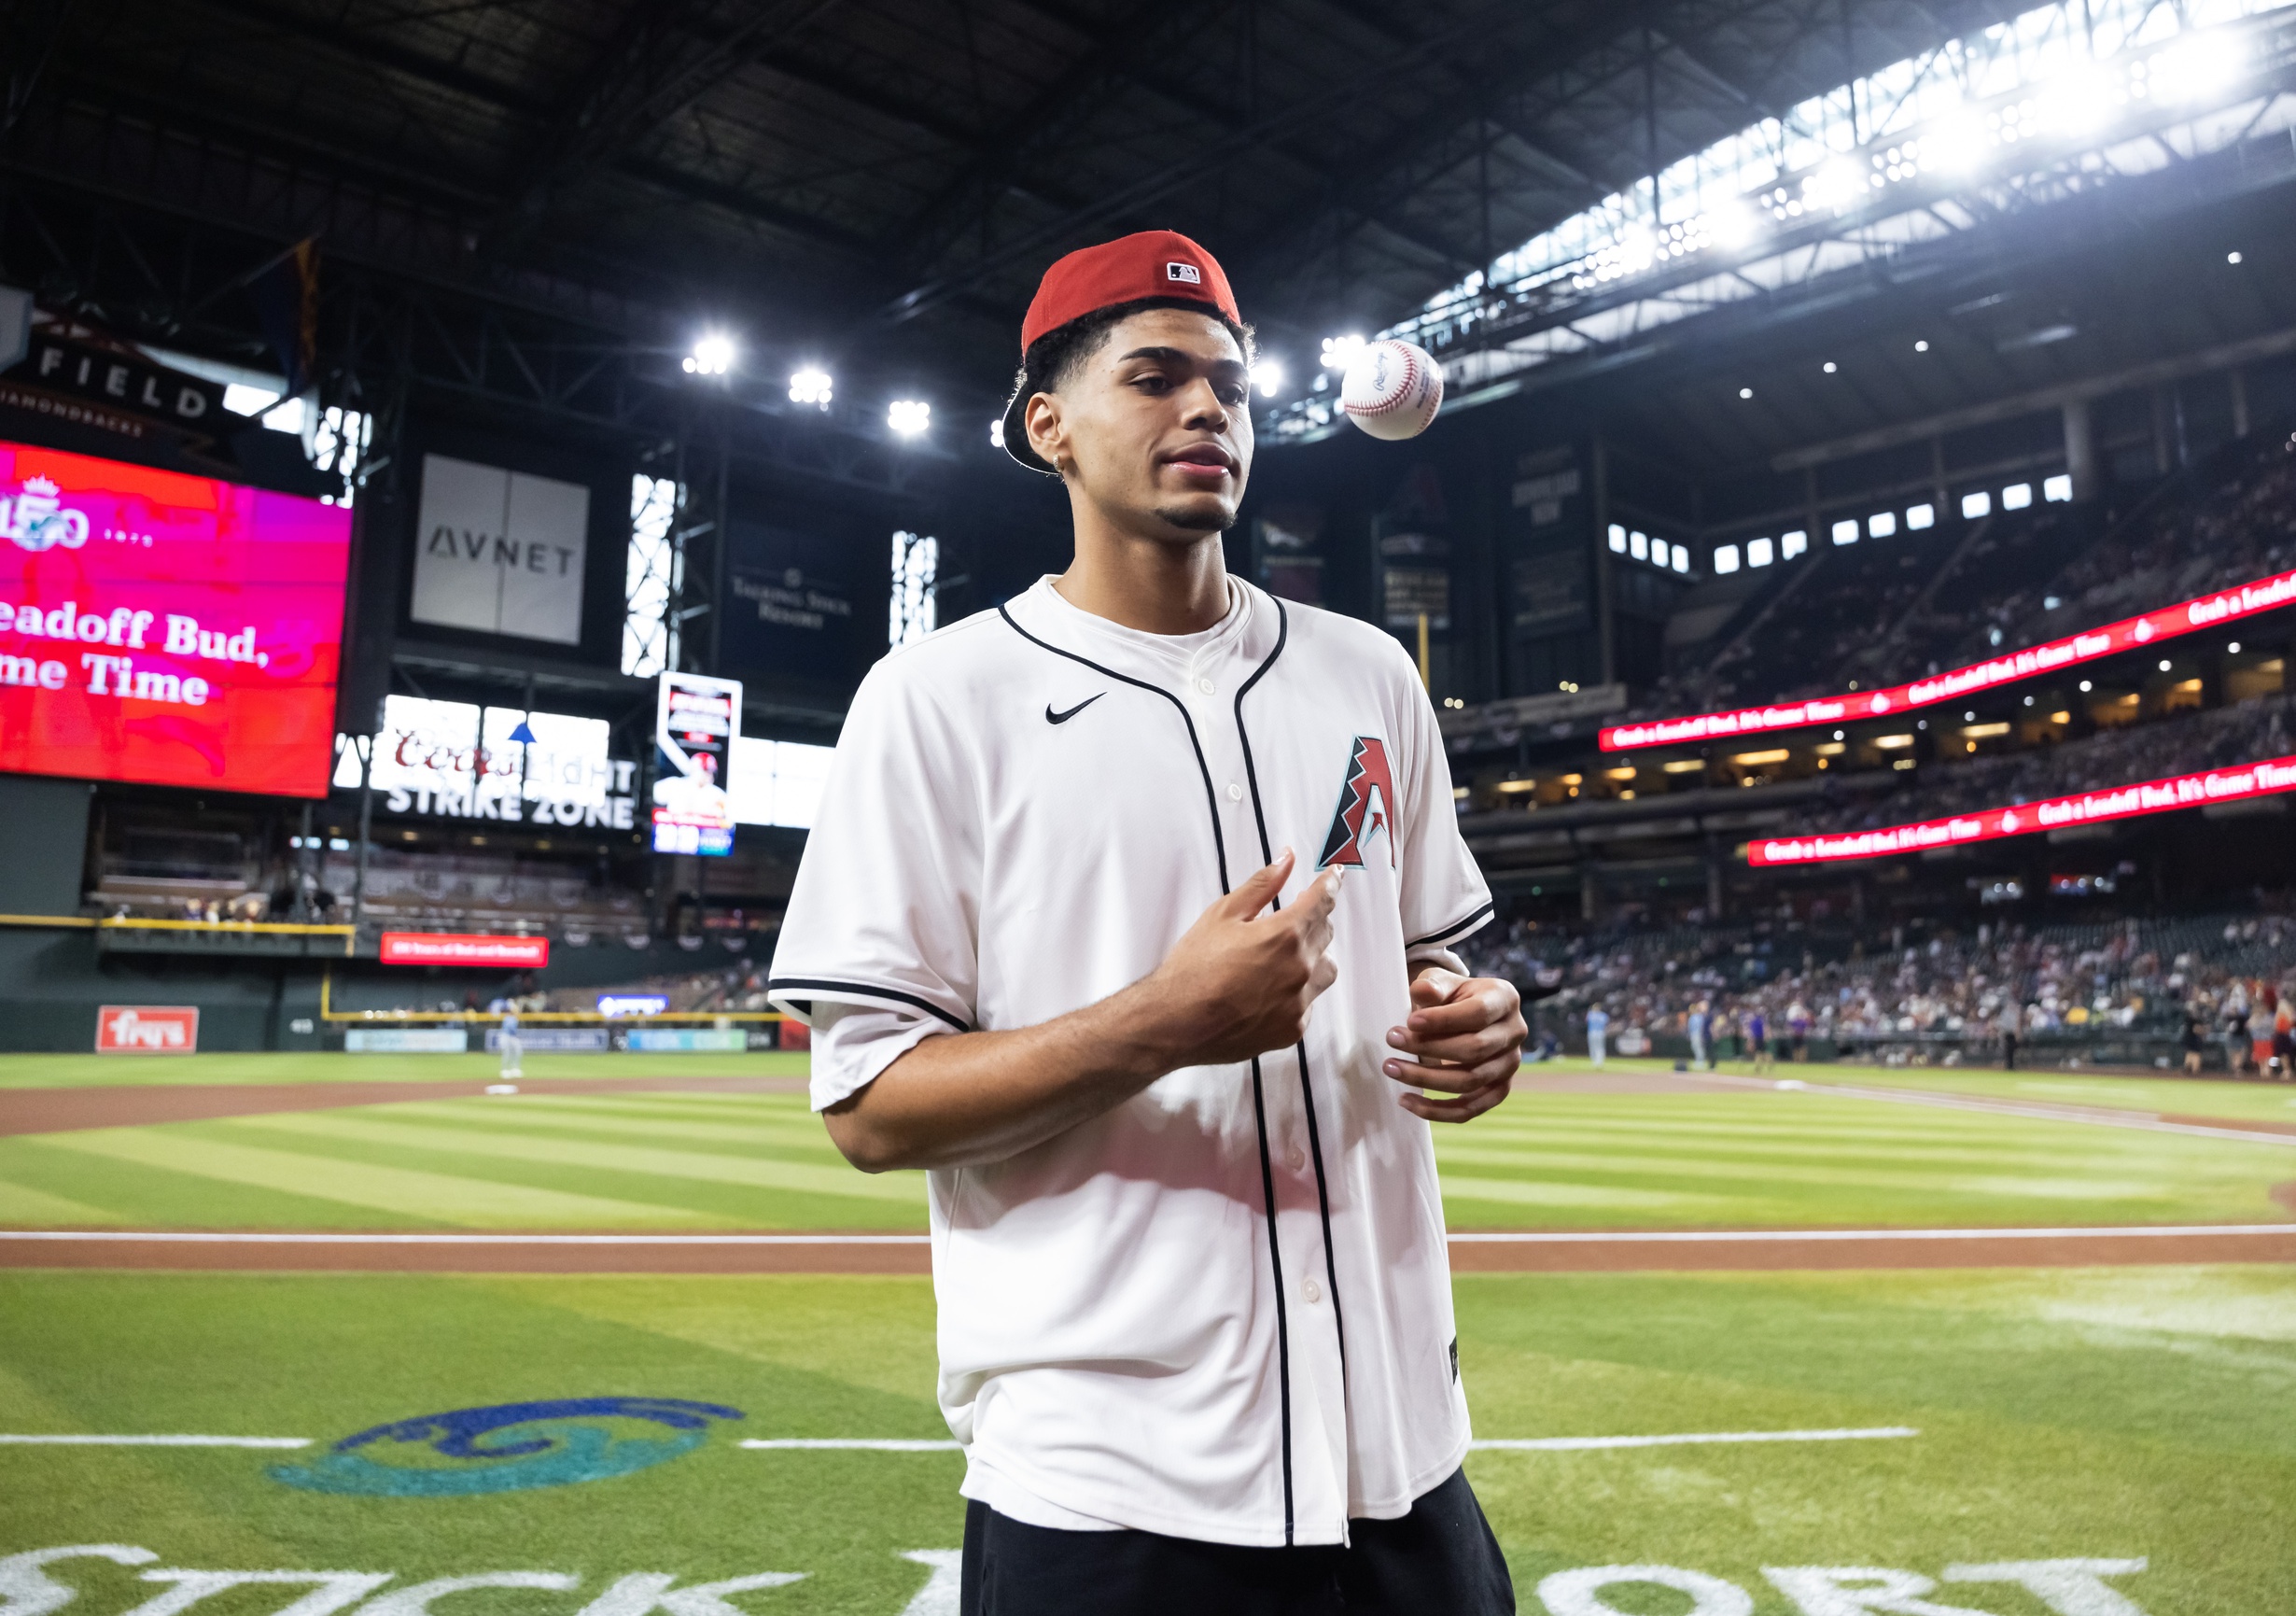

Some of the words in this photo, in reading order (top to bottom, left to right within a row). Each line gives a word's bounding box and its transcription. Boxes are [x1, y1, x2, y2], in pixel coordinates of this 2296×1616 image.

[40, 346, 208, 418] FIELD
[0, 389, 142, 438] IAMONDBACKS
[427, 526, 577, 580] AVNET
[2242, 572, 2296, 611] Leadof
[0, 600, 154, 649] eadoff
[163, 613, 269, 669] Bud,
[0, 654, 68, 690] me
[81, 652, 209, 706] Time
[385, 785, 522, 822] STRIKE
[531, 797, 635, 830] ZONE
